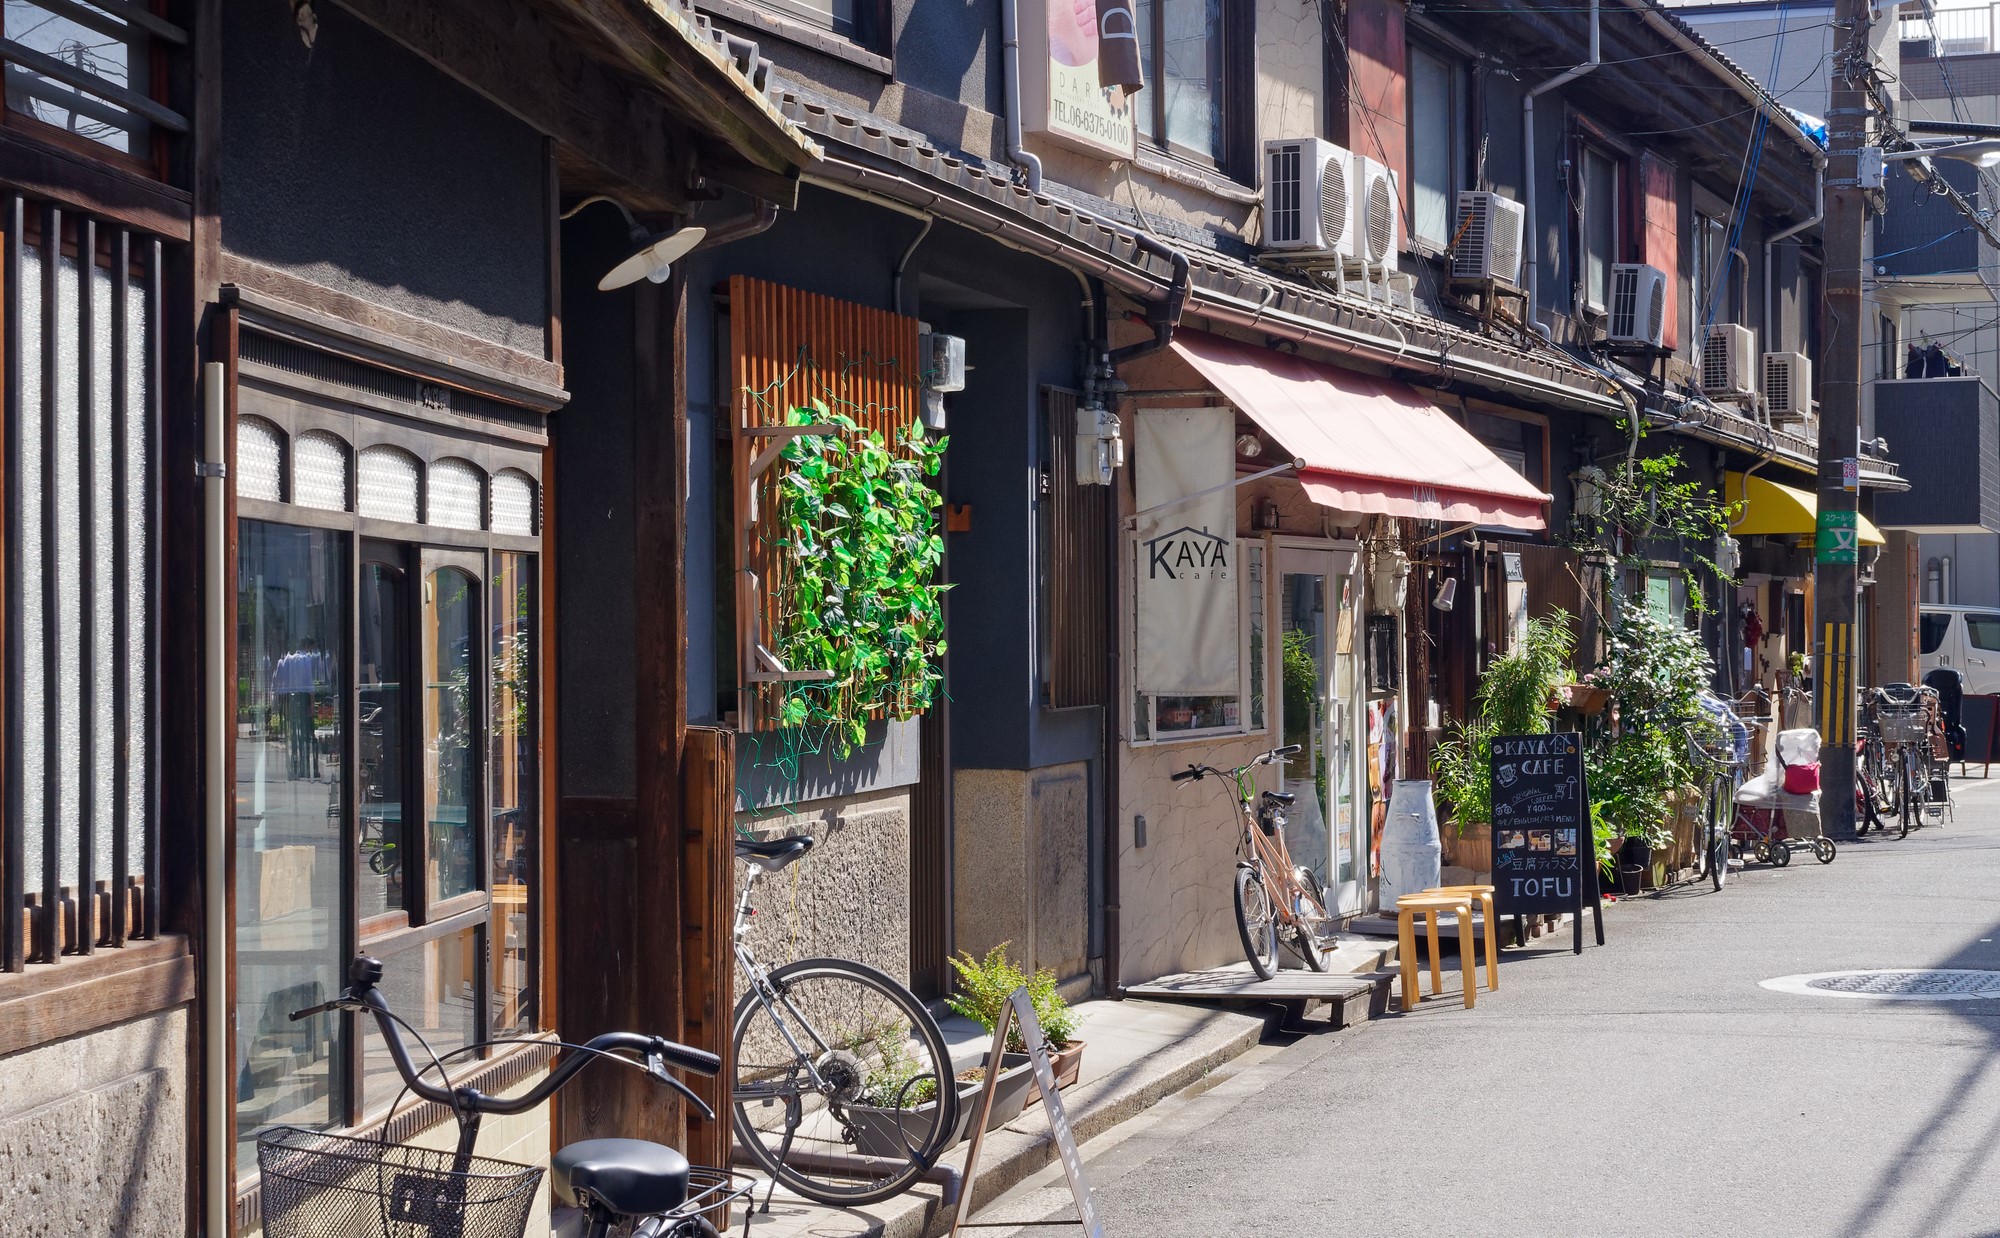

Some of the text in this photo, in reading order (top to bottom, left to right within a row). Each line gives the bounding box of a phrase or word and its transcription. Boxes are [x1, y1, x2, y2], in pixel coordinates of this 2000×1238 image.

[1843, 464, 1857, 472] 932
[1843, 471, 1857, 479] 492
[1149, 540, 1227, 579] KAYA
[1179, 570, 1227, 580] cafe
[1504, 740, 1549, 756] KAYA
[1521, 758, 1564, 775] CAFE
[1512, 856, 1579, 871] 豆腐ティラミス
[1510, 877, 1572, 898] TOFU
[867, 1172, 901, 1192] ESCAPE
